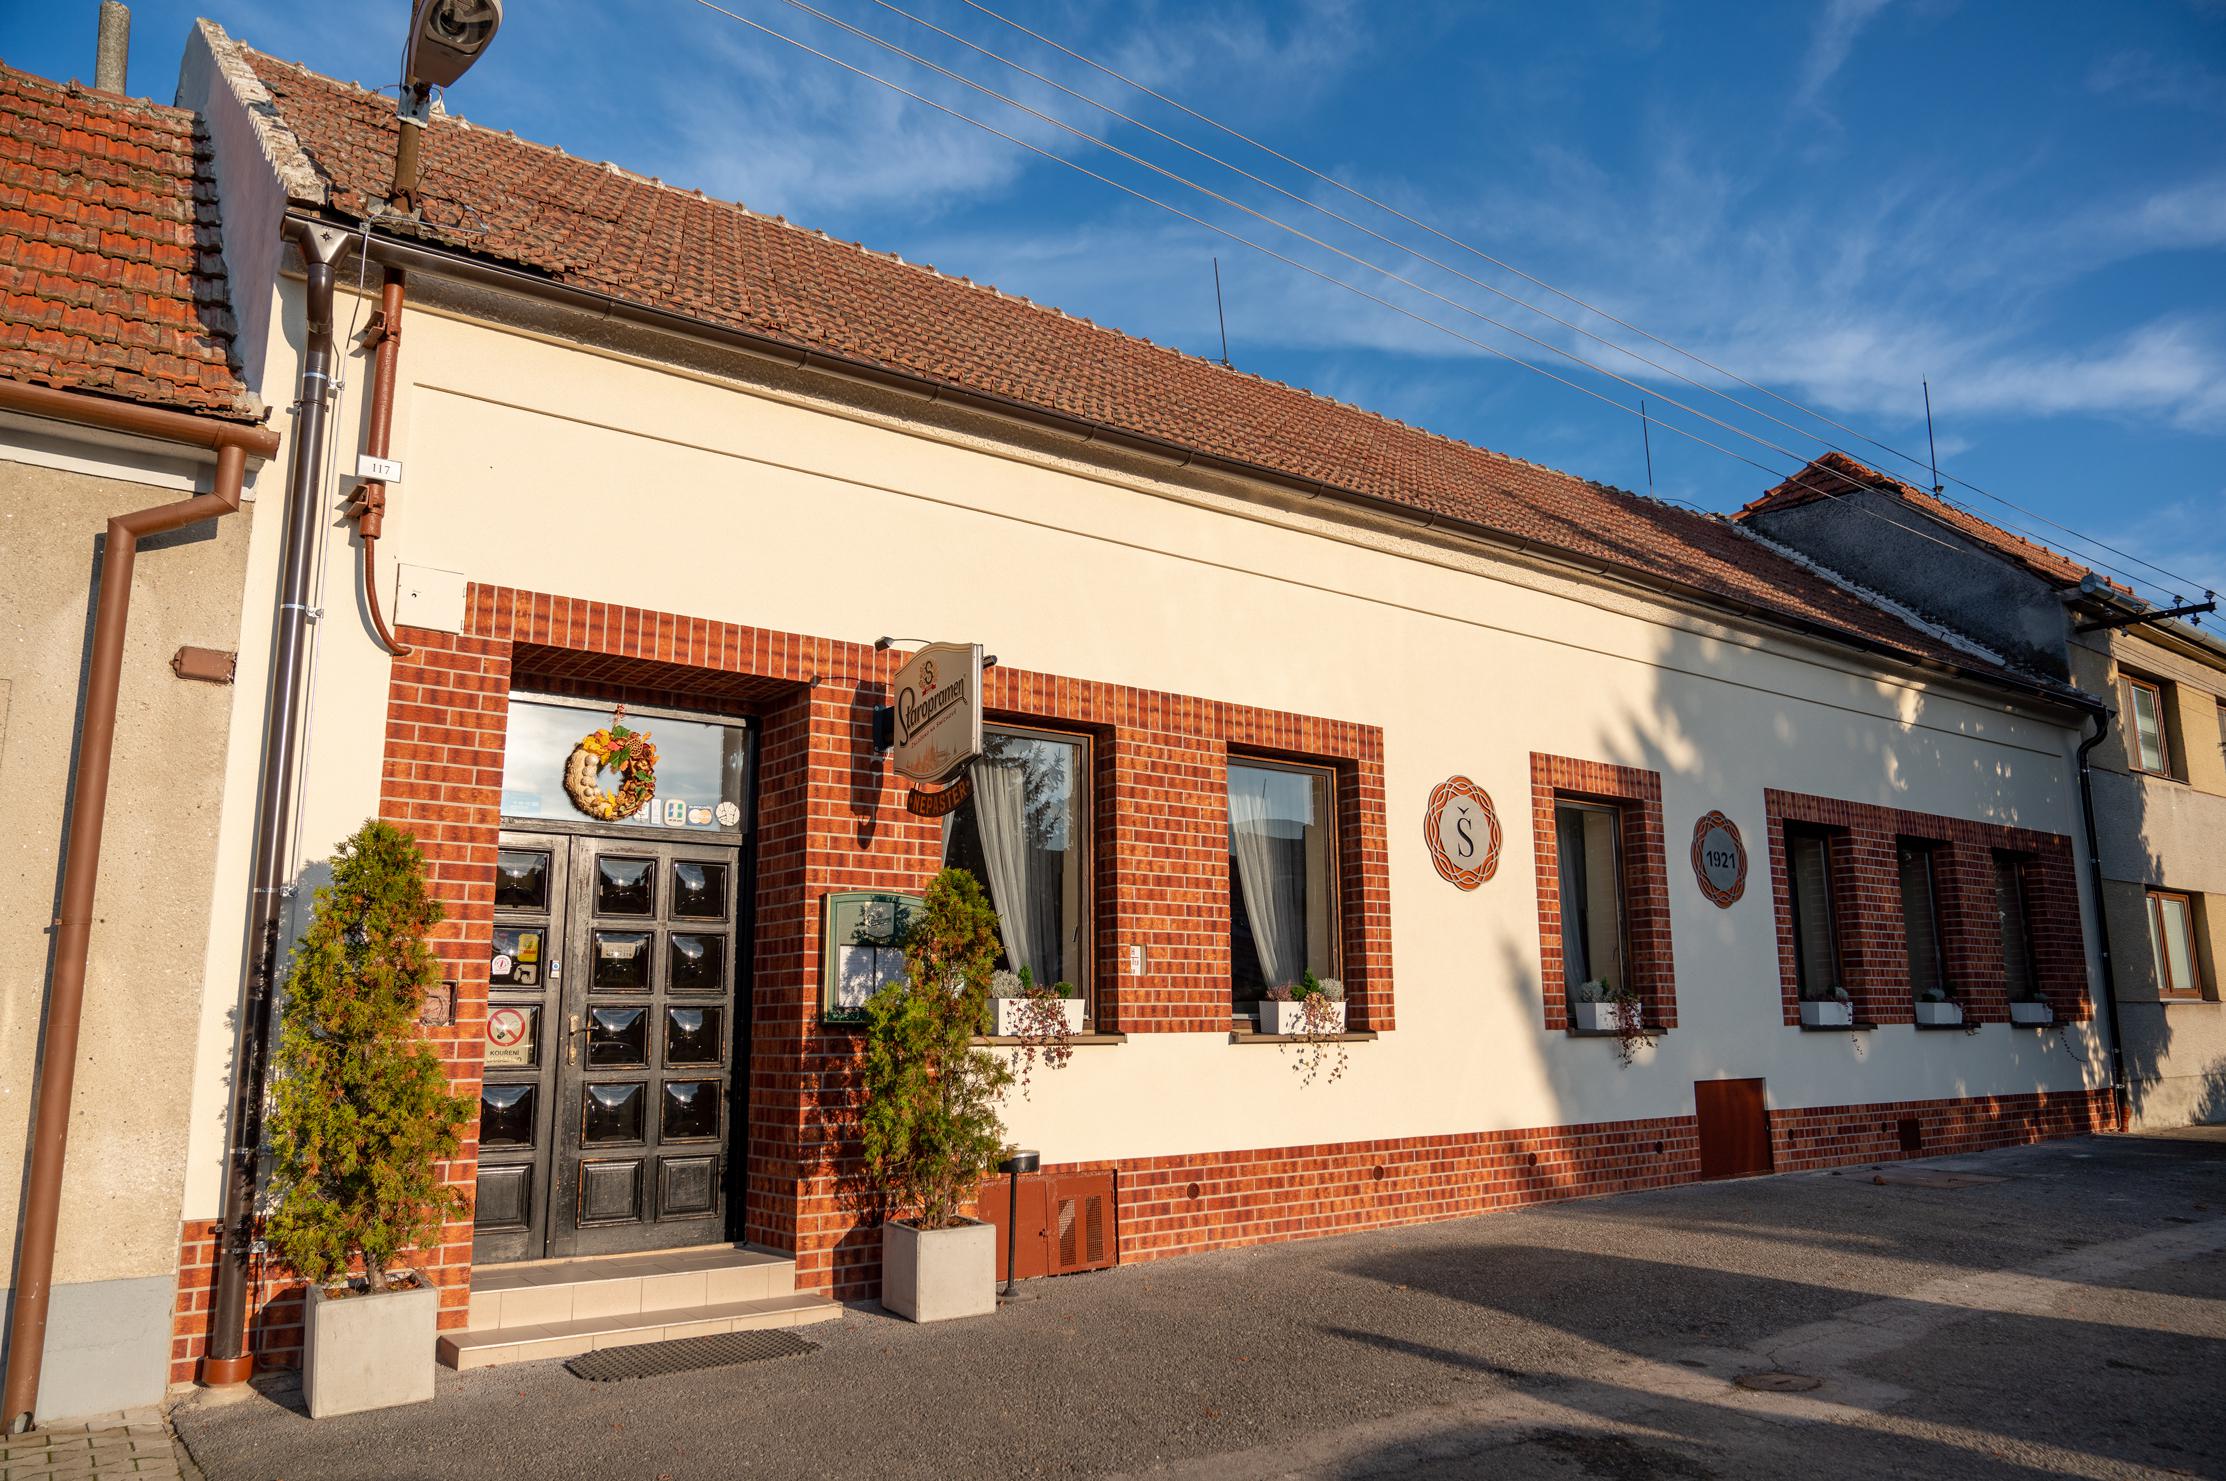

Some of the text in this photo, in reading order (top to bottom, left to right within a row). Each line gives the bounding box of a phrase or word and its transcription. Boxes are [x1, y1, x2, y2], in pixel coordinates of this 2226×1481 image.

[372, 463, 390, 475] 117
[898, 678, 968, 747] Staropramen
[913, 783, 968, 815] NEPASTER
[1457, 806, 1474, 858] Š
[1706, 850, 1736, 869] 1921
